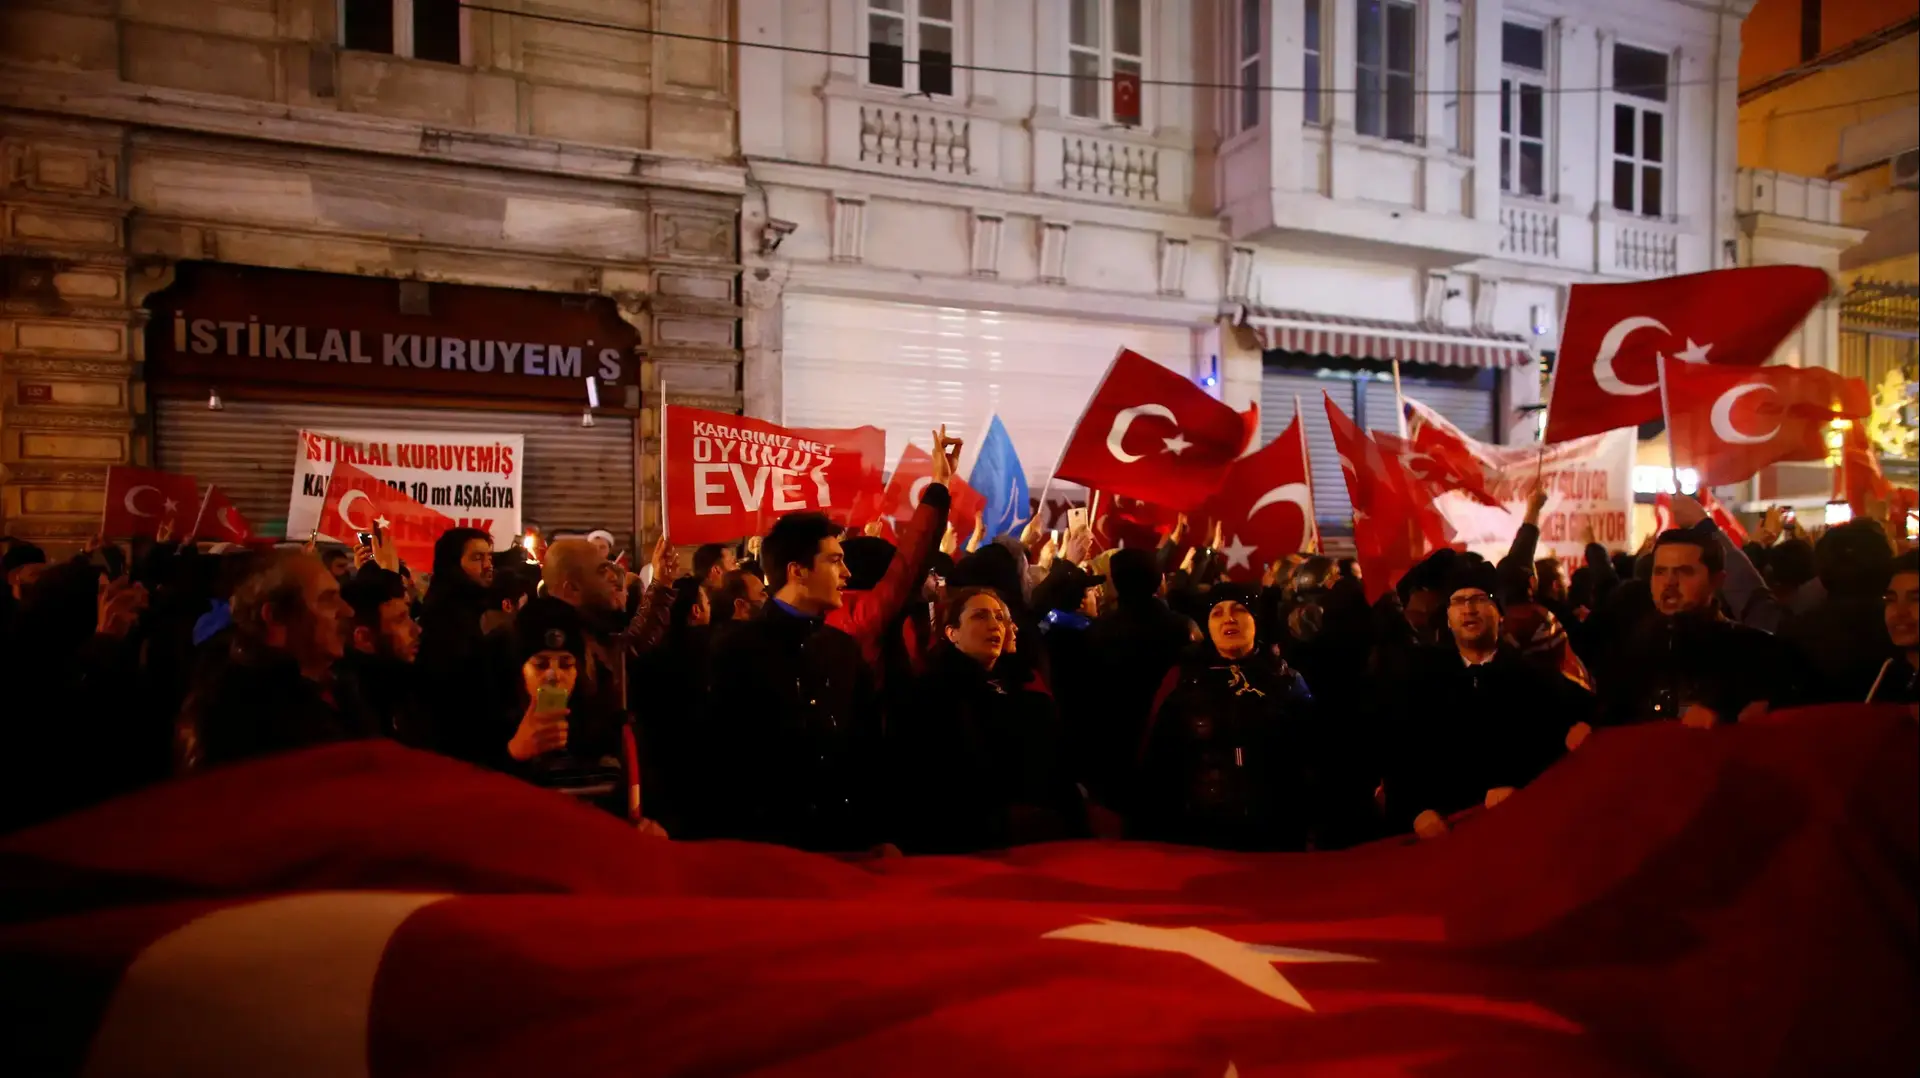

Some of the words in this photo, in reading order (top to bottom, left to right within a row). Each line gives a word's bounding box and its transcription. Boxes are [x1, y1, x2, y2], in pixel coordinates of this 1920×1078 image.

[174, 310, 372, 365] İSTİKLAL
[383, 331, 622, 386] KURUYEMŞ
[693, 420, 793, 450] KARARIMIZ
[798, 439, 836, 457] NET
[693, 436, 834, 475] OYUMUZ
[397, 441, 514, 480] KURUYEMİŞ
[410, 482, 428, 505] 10
[431, 485, 452, 506] mt
[454, 481, 514, 512] AŞAĞIYA
[694, 462, 833, 516] EVET
